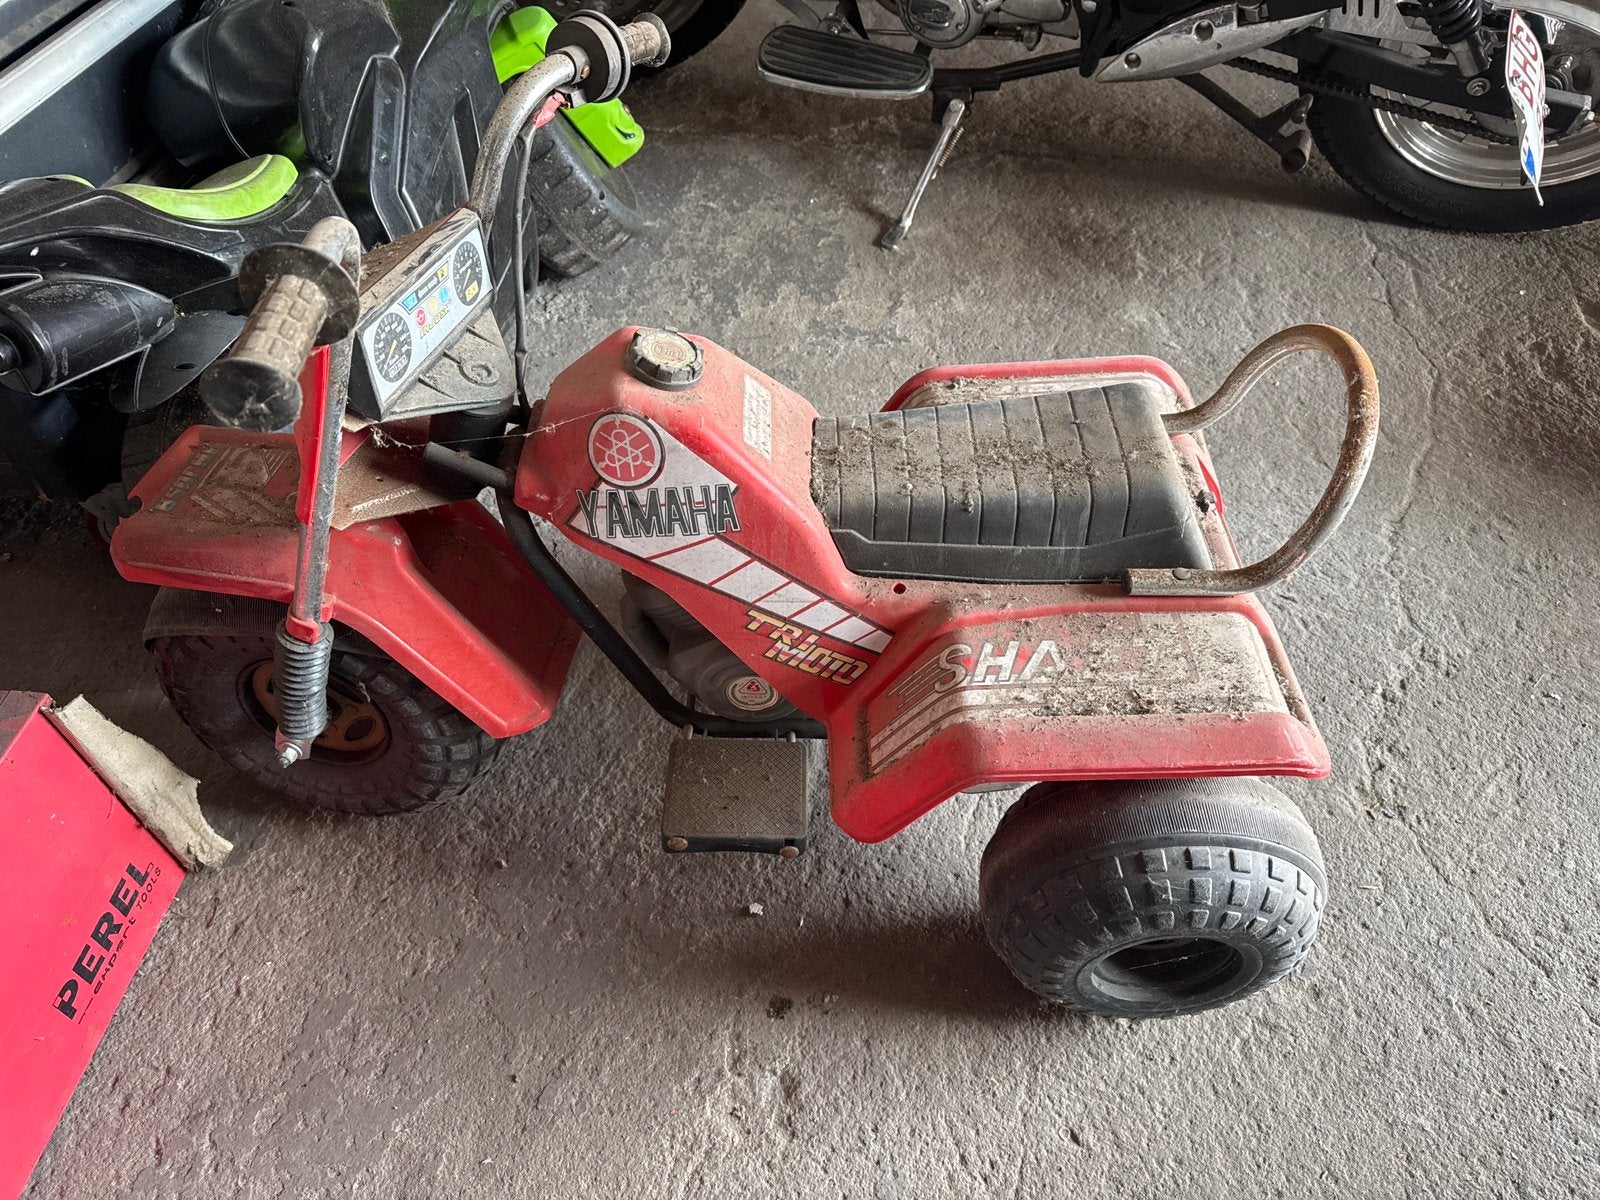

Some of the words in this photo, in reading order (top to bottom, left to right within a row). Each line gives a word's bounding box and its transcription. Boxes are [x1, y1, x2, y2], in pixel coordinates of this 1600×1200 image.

[576, 483, 740, 538] YAMAHA
[744, 608, 822, 652] TRI
[762, 641, 871, 686] MOTO
[136, 866, 162, 910] TOOLS
[52, 862, 154, 1020] PEREL
